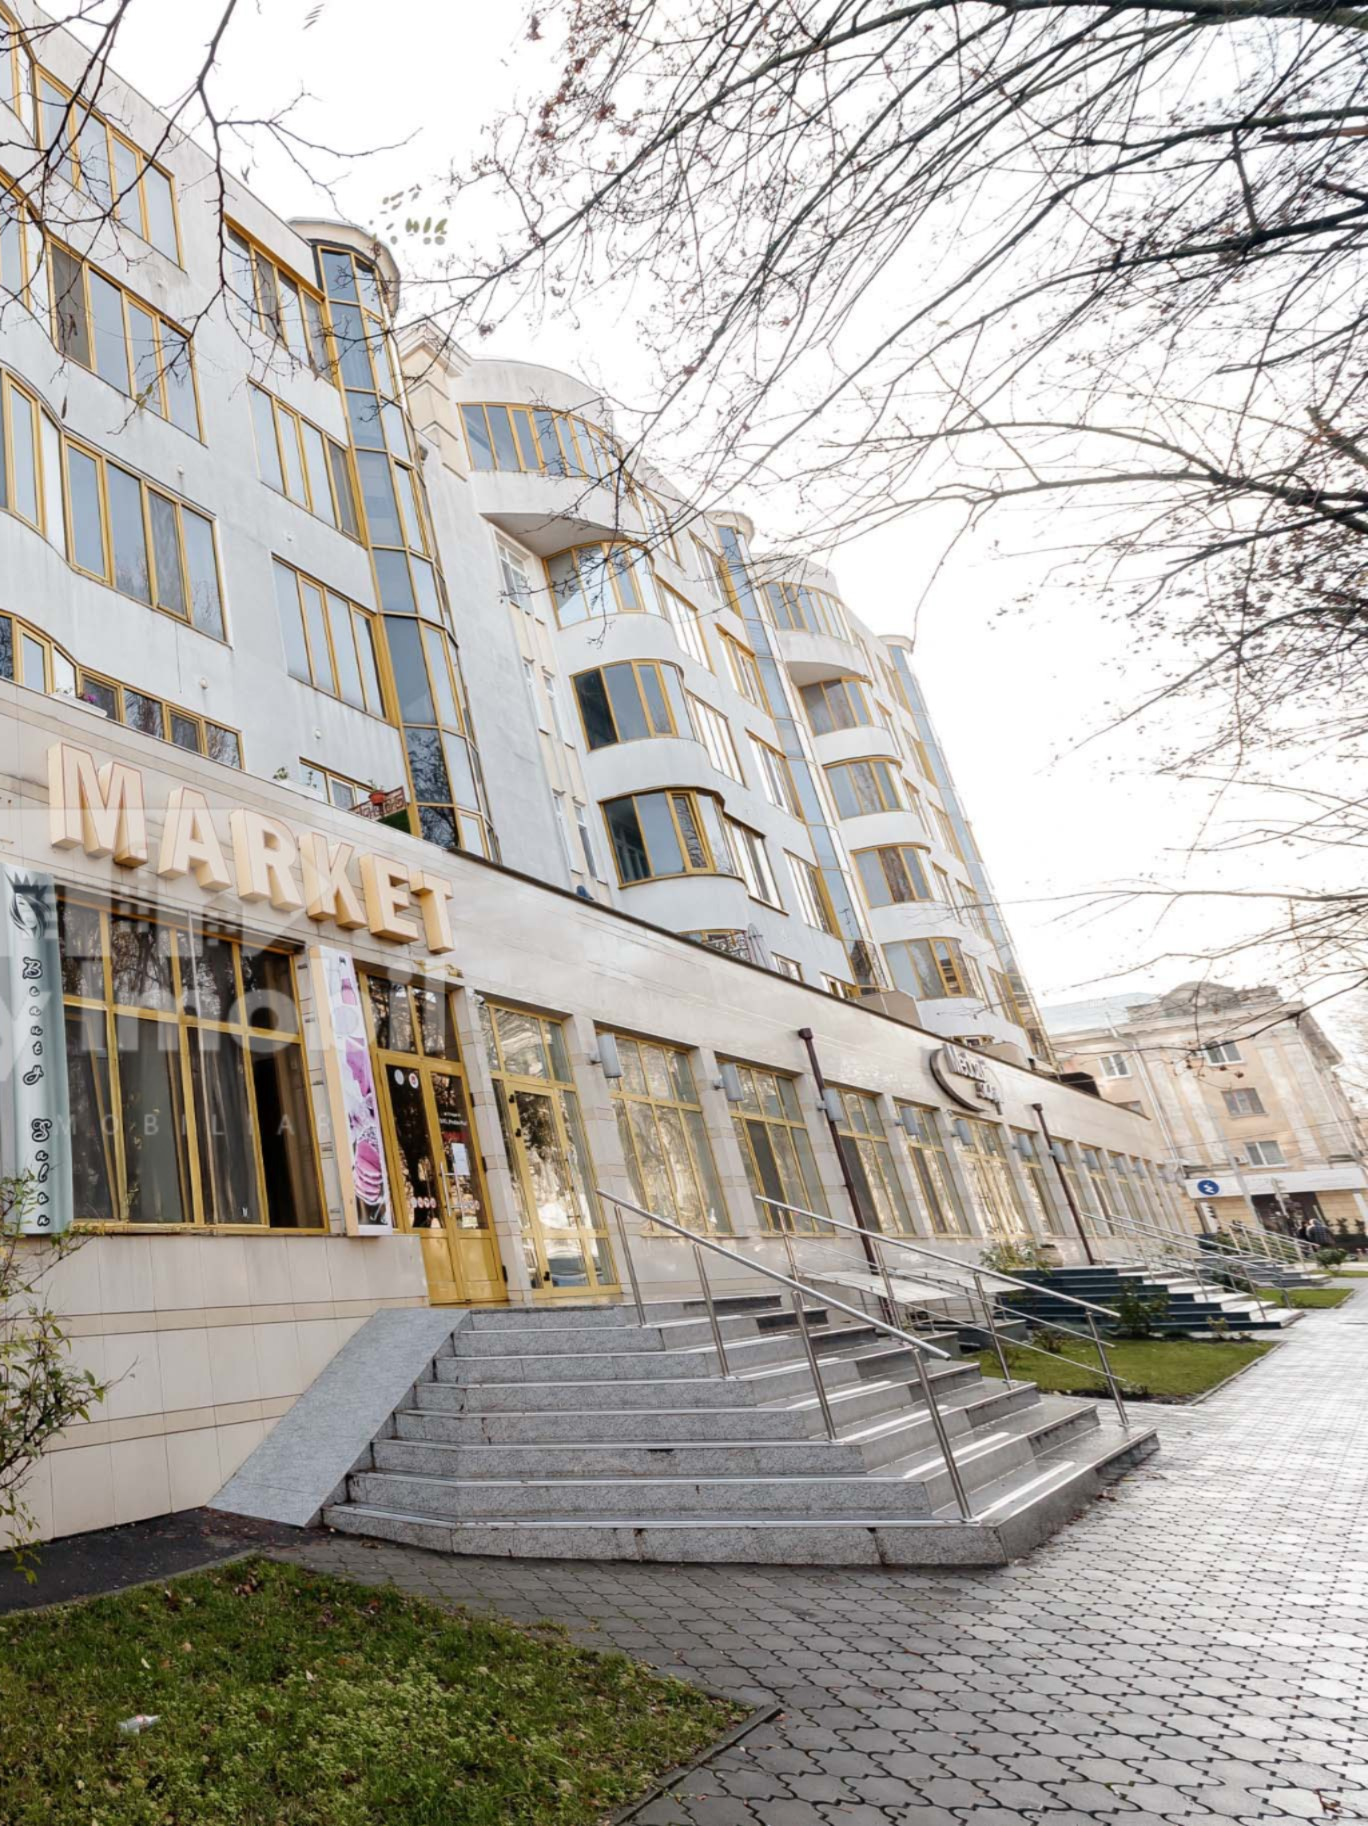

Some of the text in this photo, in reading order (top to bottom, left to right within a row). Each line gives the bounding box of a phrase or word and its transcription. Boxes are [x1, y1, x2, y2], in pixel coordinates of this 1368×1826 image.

[47, 742, 455, 955] MARKET
[22, 957, 53, 1227] Beauty Salon
